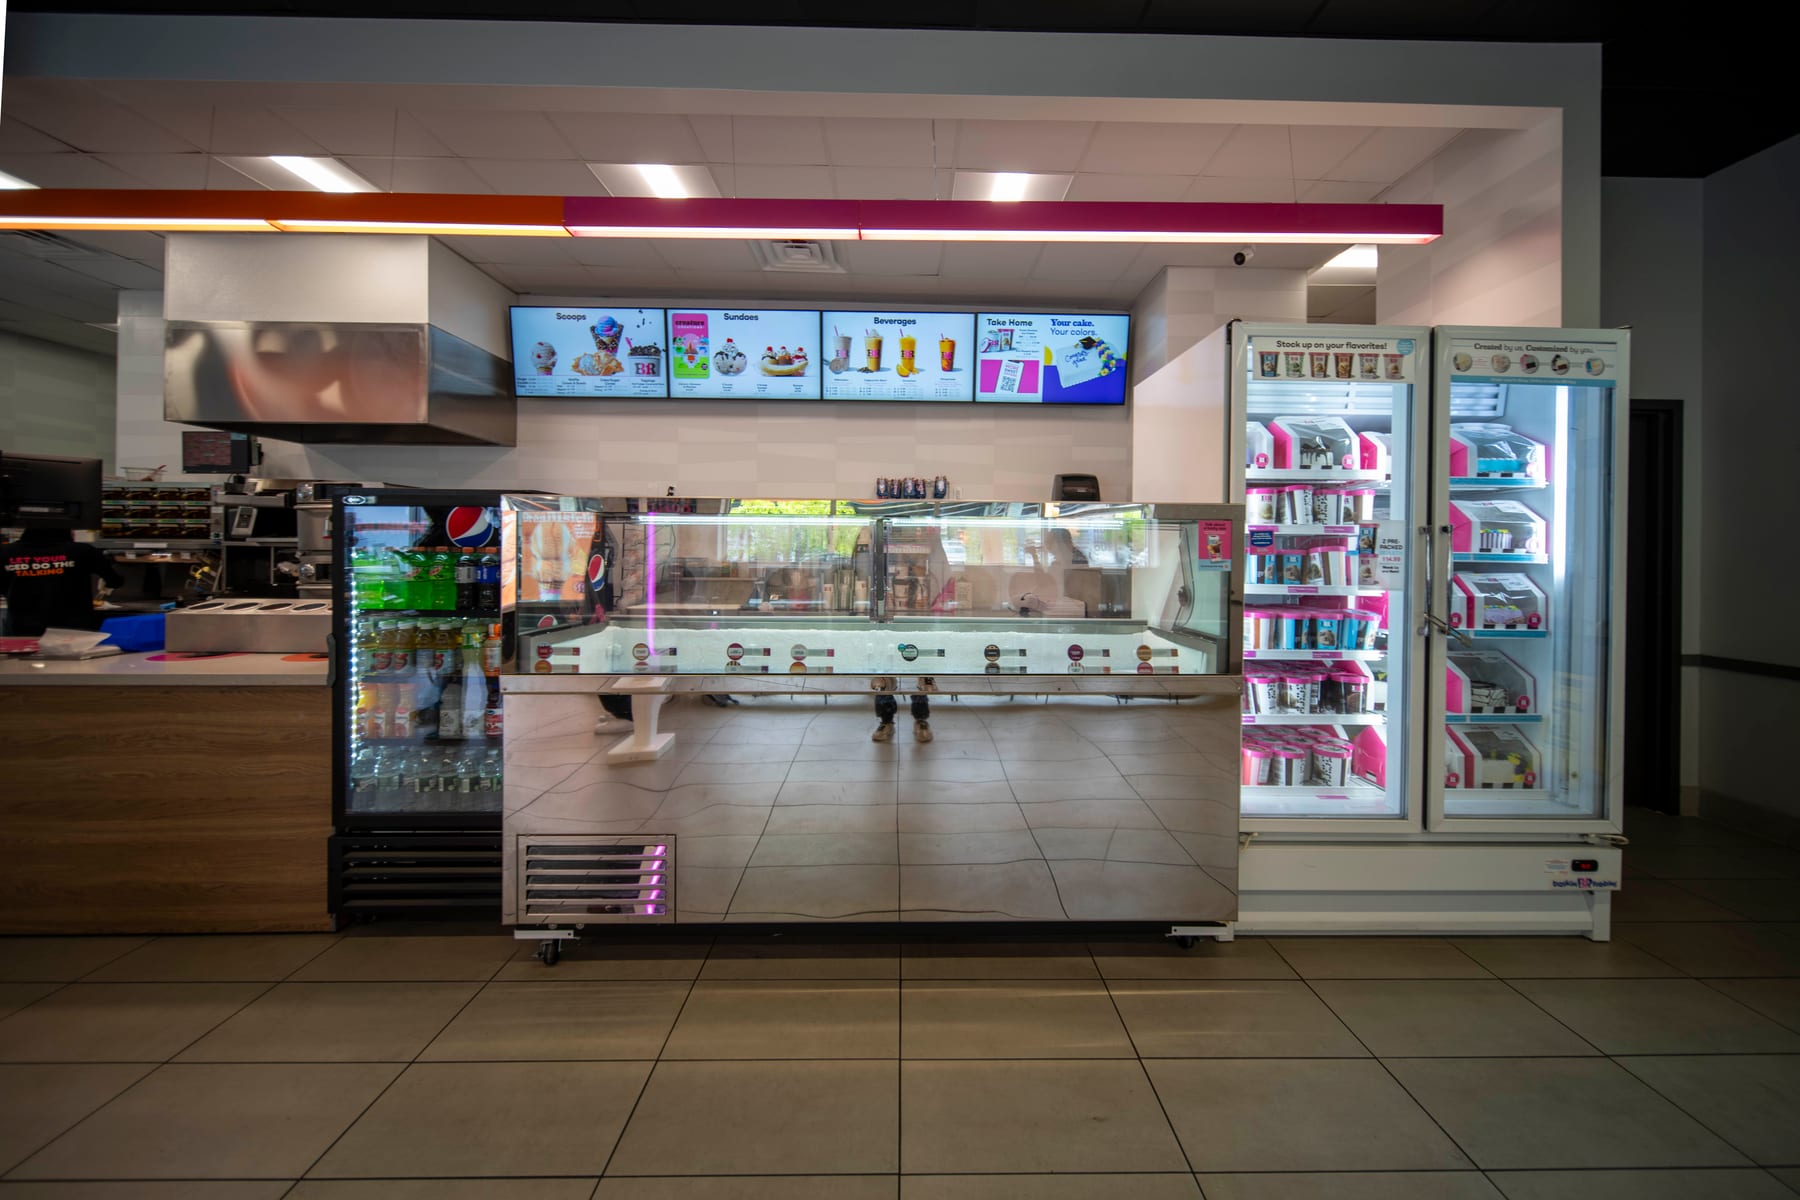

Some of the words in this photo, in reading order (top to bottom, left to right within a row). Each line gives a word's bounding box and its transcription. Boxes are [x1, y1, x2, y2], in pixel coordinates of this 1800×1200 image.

[556, 312, 587, 322] Scoops
[723, 312, 759, 321] Sundaes
[873, 316, 917, 327] Beverages
[987, 318, 1007, 327] Take
[1008, 319, 1033, 327] Home
[1050, 318, 1071, 327] Your
[1072, 319, 1095, 327] cake.
[1050, 327, 1069, 336] Your
[1070, 328, 1098, 337] colors.
[1276, 340, 1301, 349] Stock
[1301, 342, 1312, 350] up
[1326, 342, 1344, 351] your
[1345, 341, 1387, 350] flavorites!
[1474, 342, 1503, 350] Created
[1503, 343, 1513, 352] by
[1525, 344, 1569, 353] Customized
[1570, 346, 1579, 354] by
[1580, 347, 1595, 355] you.
[31, 562, 51, 570] DO
[52, 560, 75, 568] THE
[15, 568, 65, 577] TALKING
